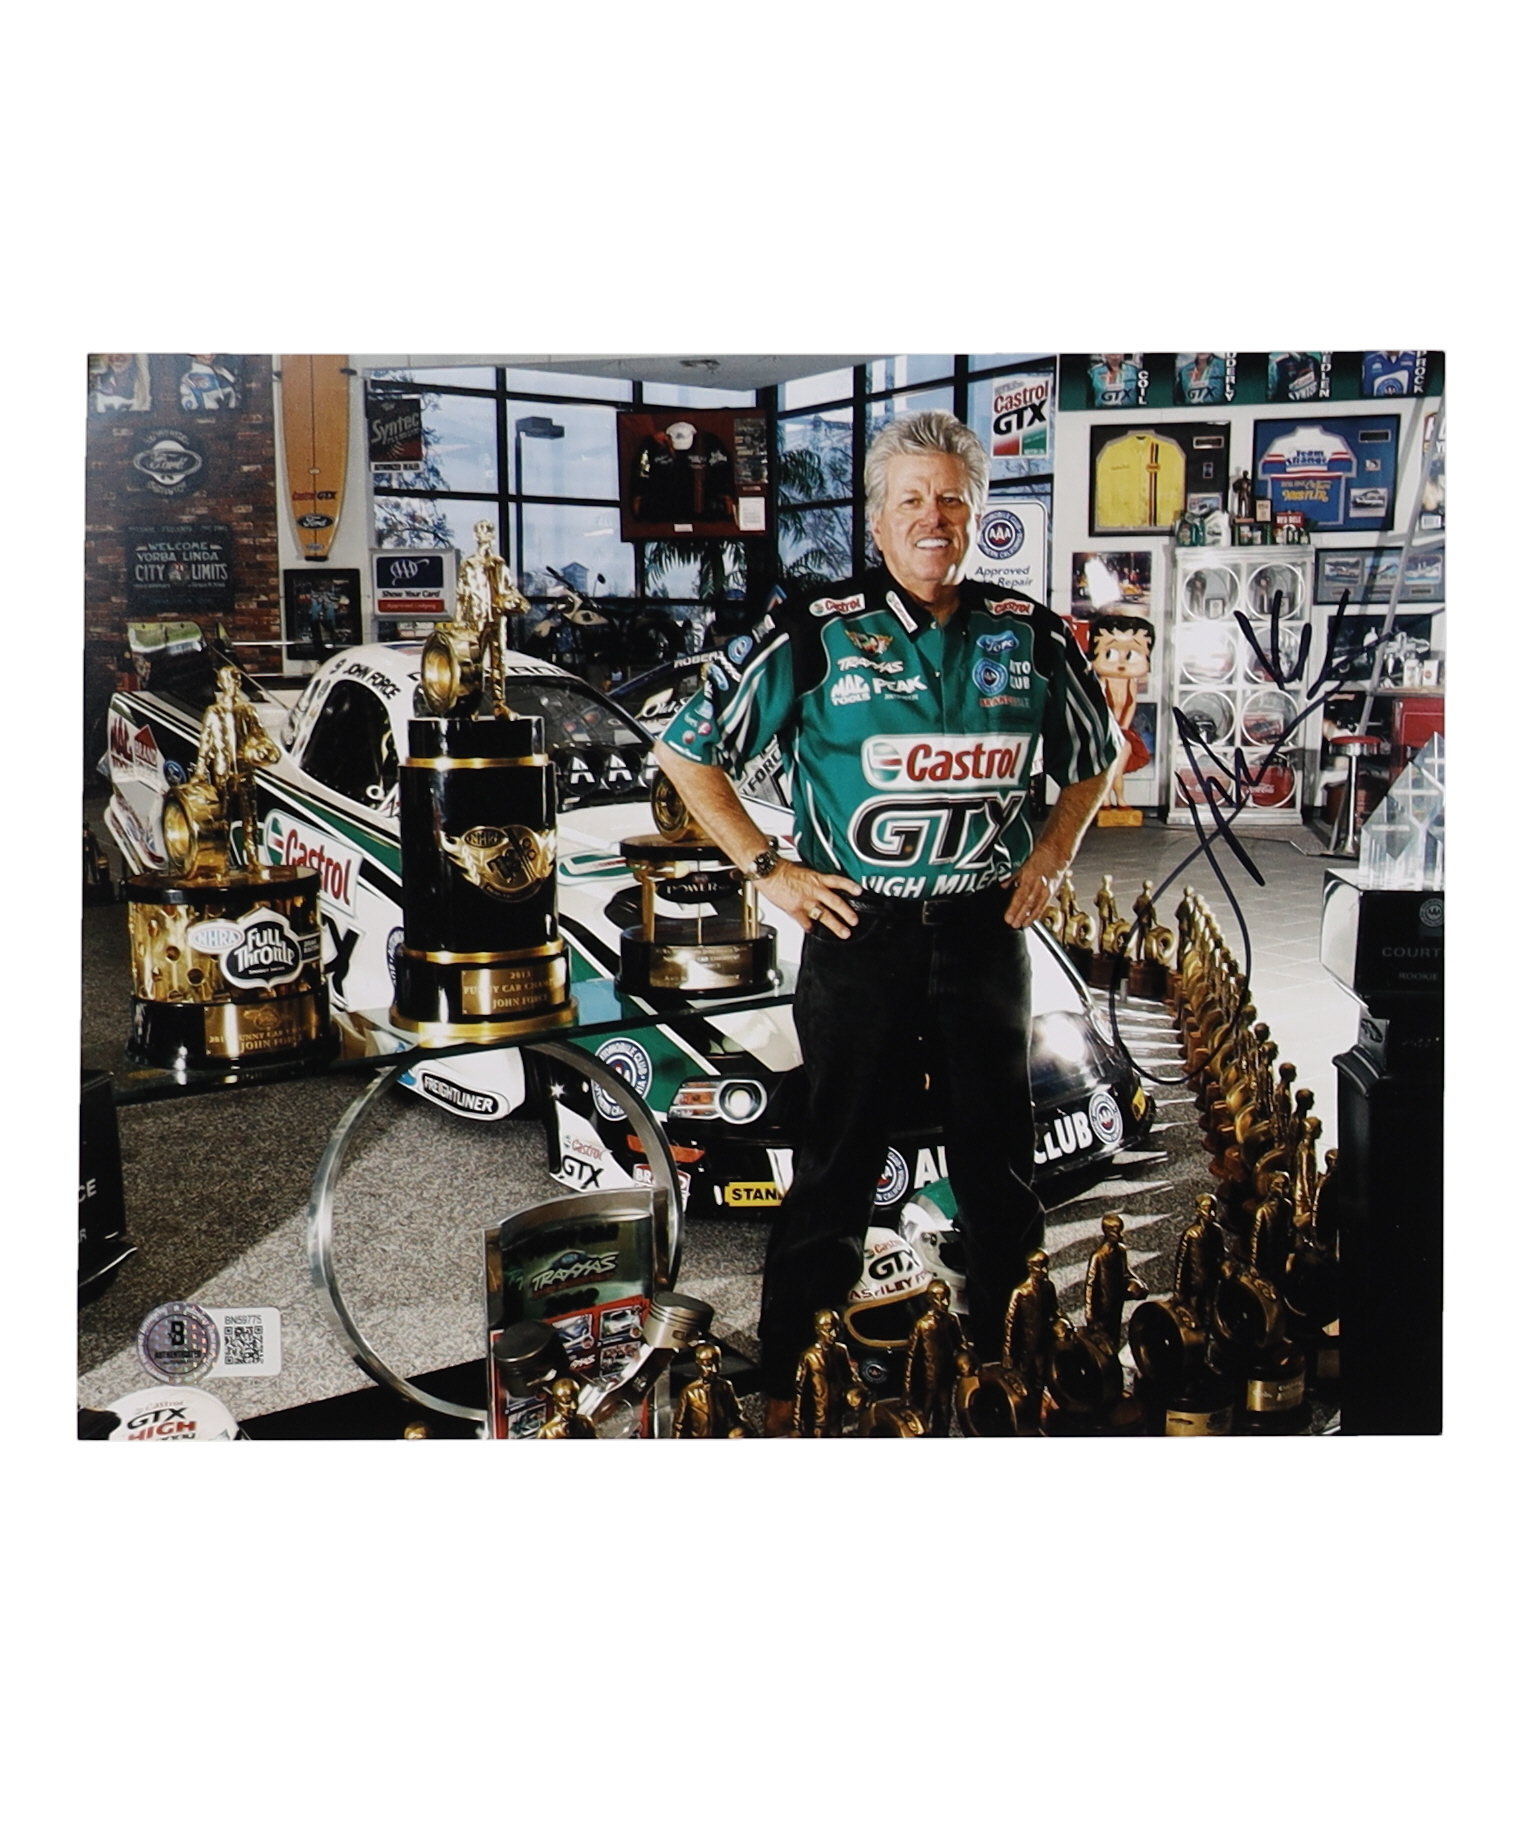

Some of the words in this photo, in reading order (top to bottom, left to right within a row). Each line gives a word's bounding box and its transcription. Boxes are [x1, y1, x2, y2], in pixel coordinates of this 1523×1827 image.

[1137, 370, 1149, 405] COIL
[993, 380, 1049, 415] Castrol
[993, 400, 1048, 436] GTX
[370, 412, 420, 446] Syntec
[303, 516, 327, 528] Ford
[989, 528, 1012, 542] AAA
[148, 542, 208, 551] WELCOME
[137, 552, 177, 562] YORBA
[182, 551, 219, 562] LINDA
[135, 564, 166, 582] CITY
[192, 563, 228, 581] LIMITS
[975, 565, 1030, 578] Approved
[998, 577, 1033, 590] Repair
[381, 590, 404, 598] Show
[405, 590, 421, 598] Your
[422, 590, 440, 598] Card
[344, 660, 369, 682] JOHN
[368, 671, 402, 700] FORCE
[872, 675, 928, 694] PEAK
[906, 742, 1022, 782] Castrol
[847, 790, 1028, 869] GTX
[284, 828, 352, 907] Castrol
[861, 875, 927, 898] HIGH
[197, 928, 238, 947] NHRA
[1398, 972, 1438, 981] ROOKIE
[463, 984, 499, 996] FUY
[501, 983, 522, 993] CAR
[492, 997, 520, 1009] JOHN
[239, 1032, 265, 1041] UNNY
[240, 1039, 271, 1053] JOHN
[423, 1074, 494, 1113] FREIGHTLINER
[571, 1139, 603, 1161] Castrol
[563, 1155, 604, 1190] GTX
[532, 1251, 620, 1292] TRAXXAS
[868, 1249, 921, 1280] GTX
[127, 1407, 187, 1430] GTX
[128, 1421, 197, 1440] HIGH
